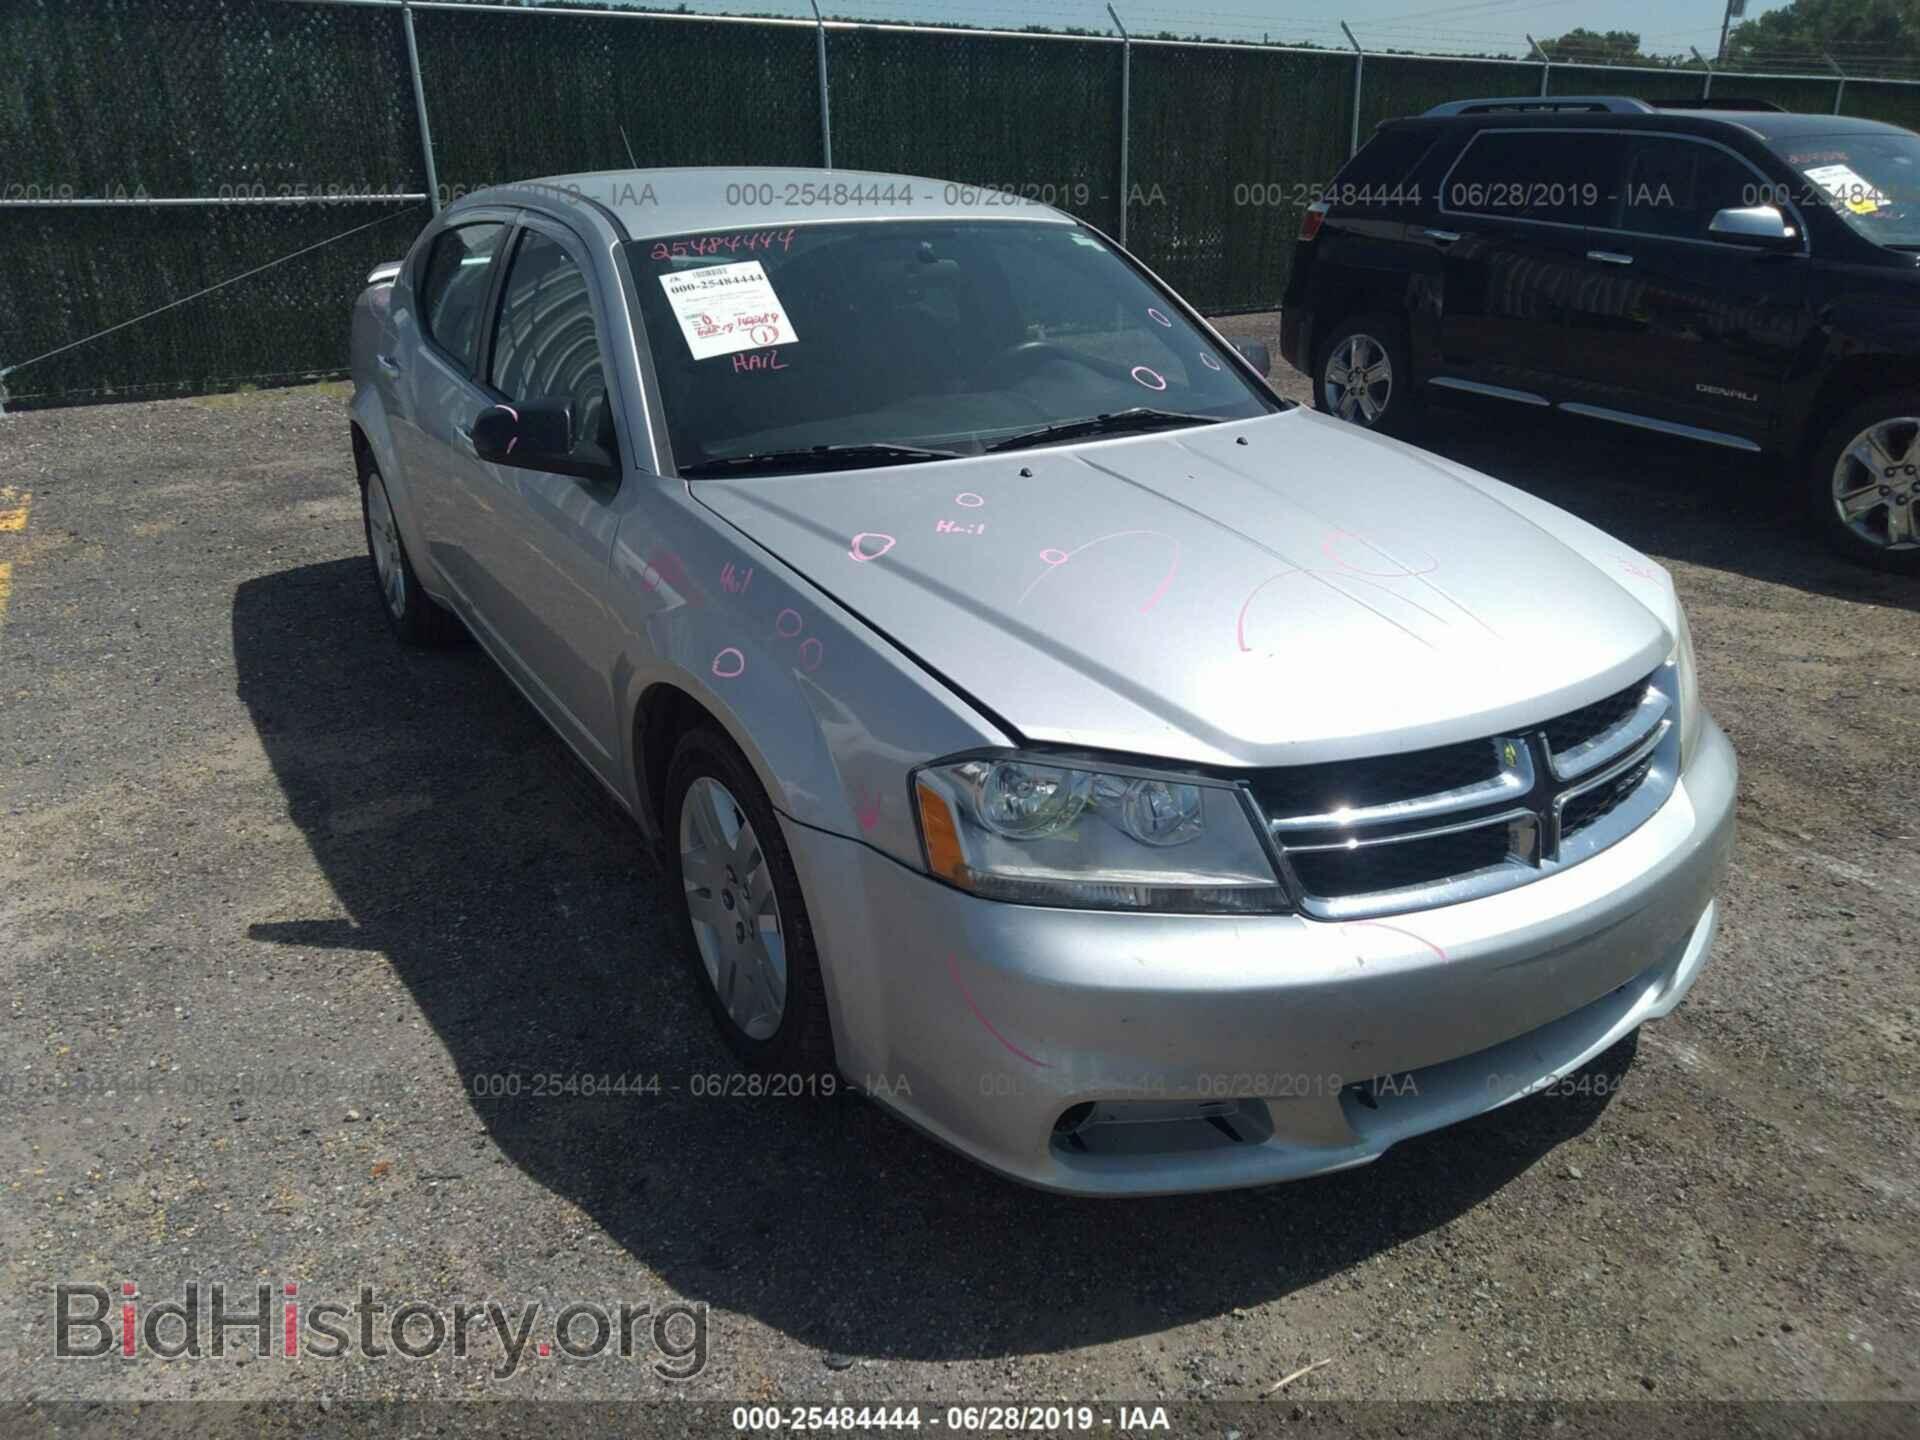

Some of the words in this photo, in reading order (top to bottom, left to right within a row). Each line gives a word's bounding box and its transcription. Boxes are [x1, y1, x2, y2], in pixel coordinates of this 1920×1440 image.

[651, 228, 796, 261] 25484444
[671, 274, 764, 295] 000-25484444
[1696, 383, 1759, 402] DENALI
